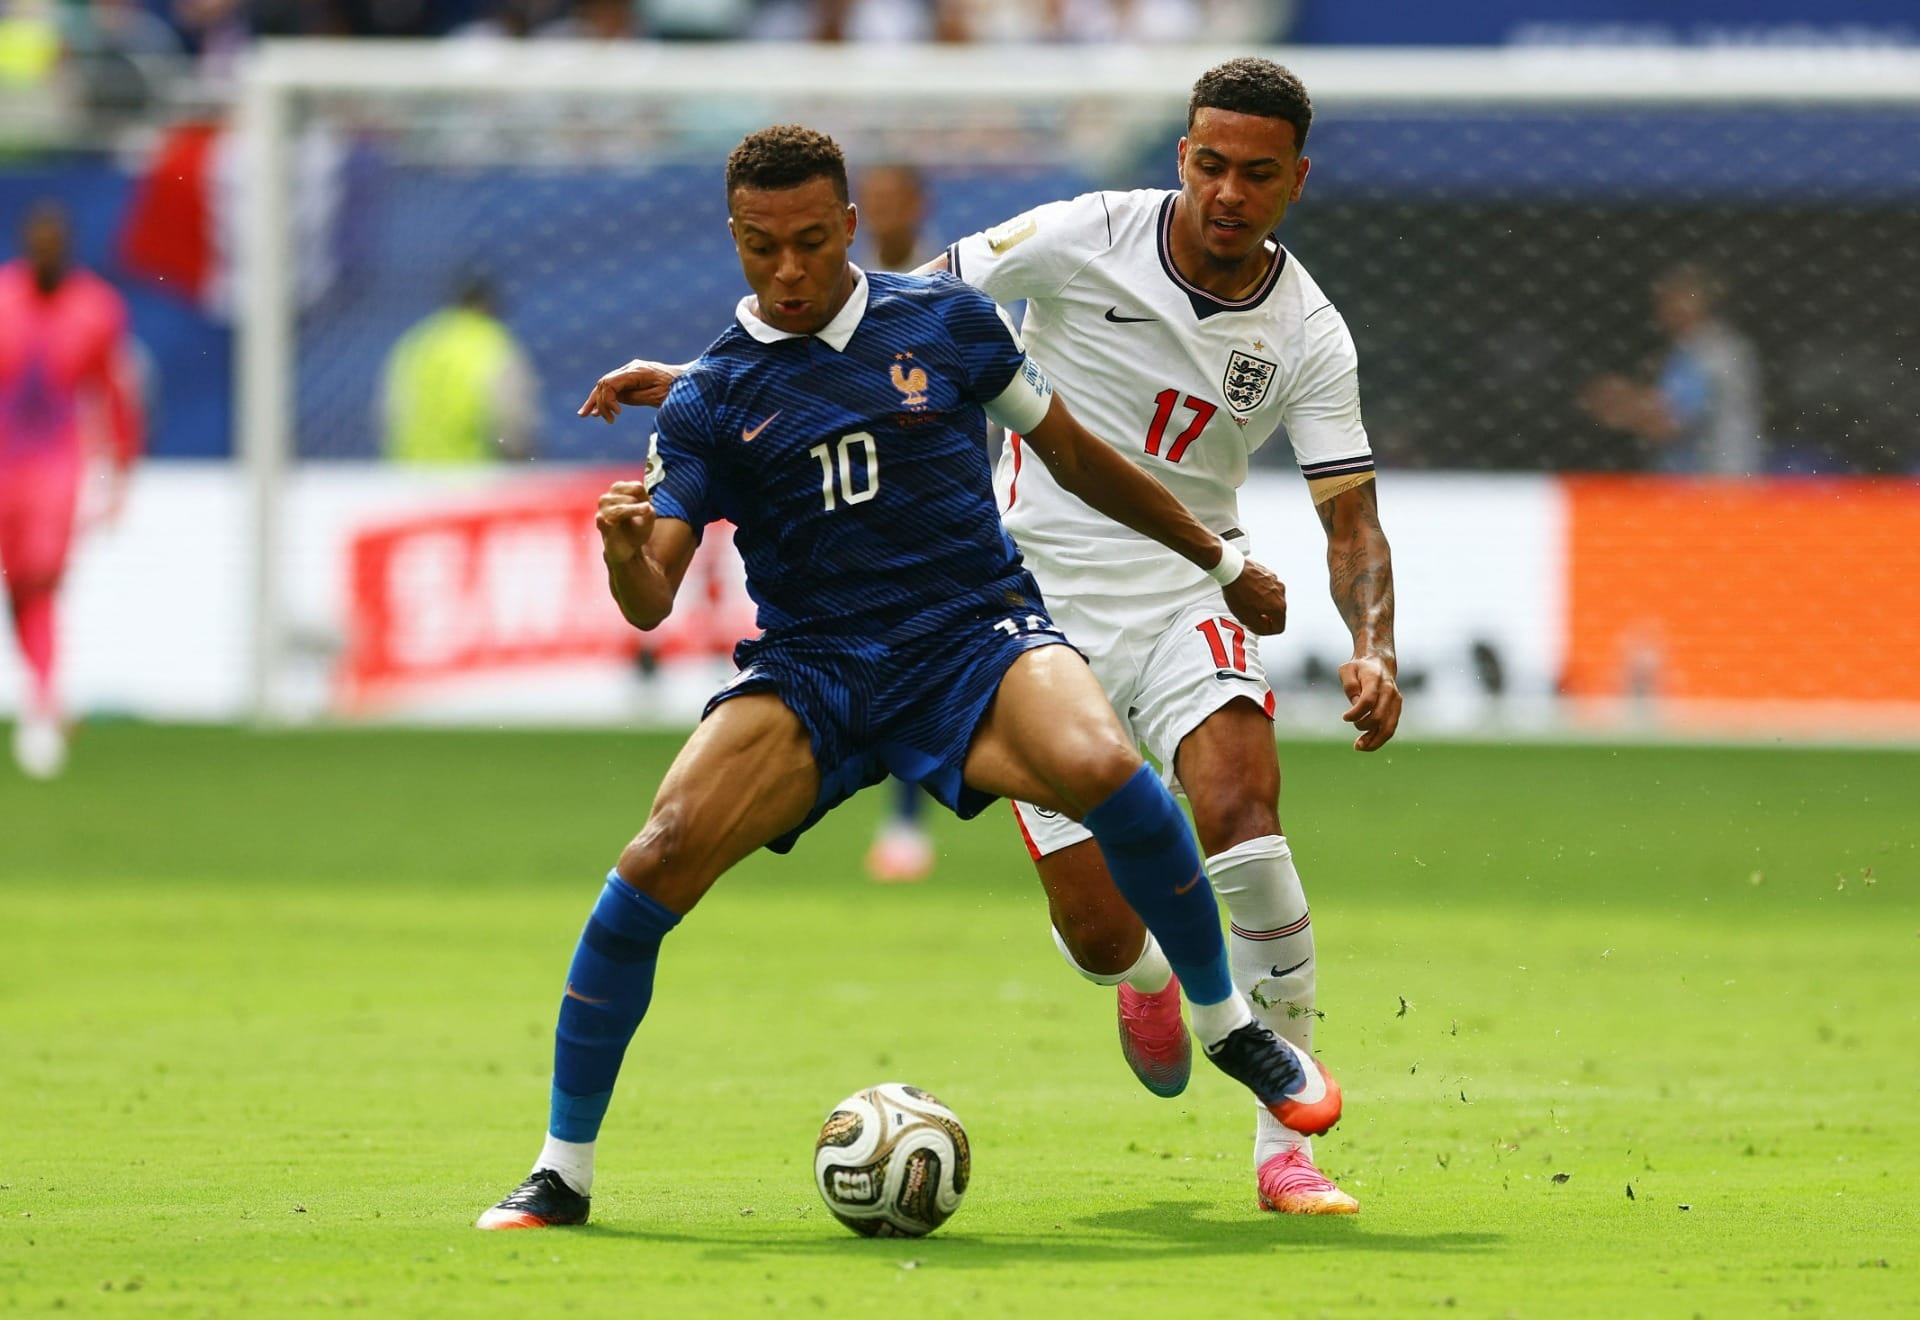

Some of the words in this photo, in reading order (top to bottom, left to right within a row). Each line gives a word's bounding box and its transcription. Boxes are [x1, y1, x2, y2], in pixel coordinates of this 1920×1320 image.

[1144, 388, 1218, 463] 17
[809, 431, 879, 512] 10
[993, 614, 1062, 636] 1
[1195, 616, 1246, 672] 17
